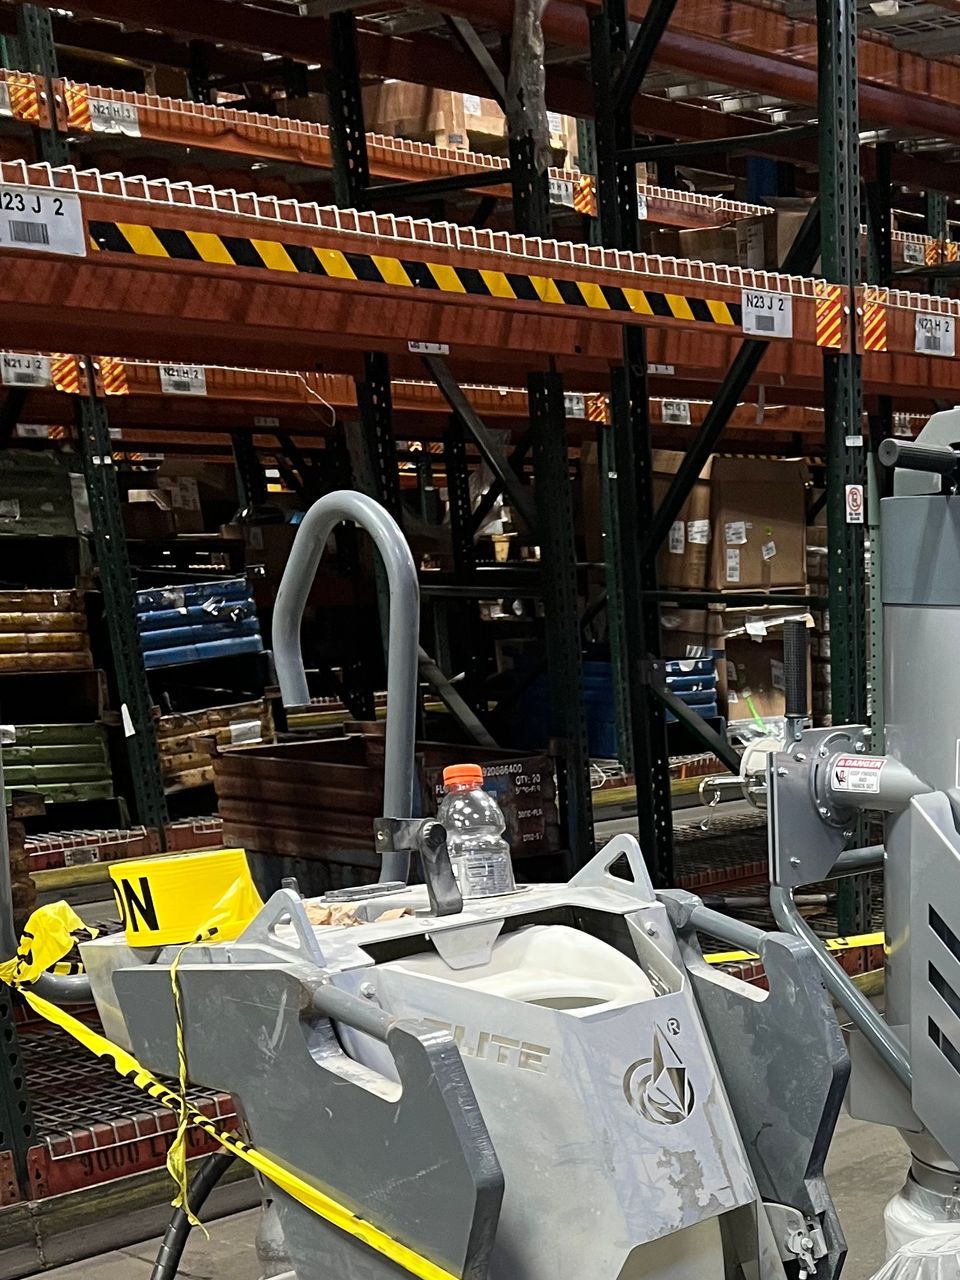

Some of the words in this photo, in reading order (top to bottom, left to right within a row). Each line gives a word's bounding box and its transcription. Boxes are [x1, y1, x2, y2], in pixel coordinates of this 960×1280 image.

[32, 195, 41, 213] J
[53, 198, 64, 216] 2
[746, 294, 765, 309] N23
[767, 297, 773, 310] J
[778, 299, 784, 311] 2
[944, 321, 950, 332] 2
[4, 358, 21, 369] N21
